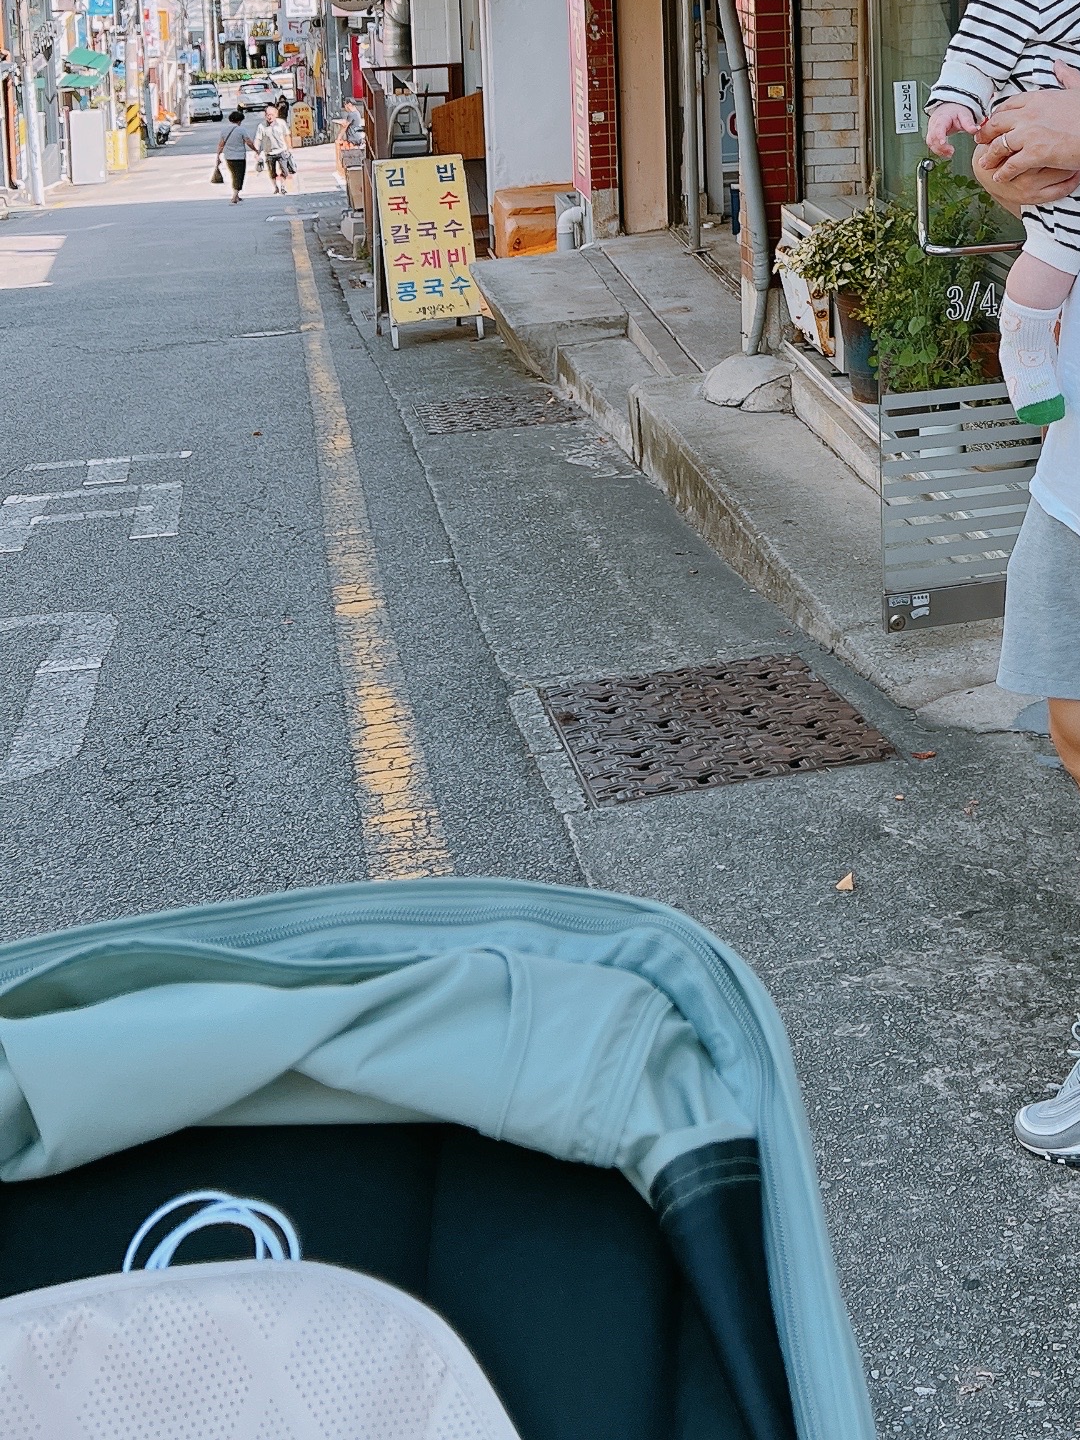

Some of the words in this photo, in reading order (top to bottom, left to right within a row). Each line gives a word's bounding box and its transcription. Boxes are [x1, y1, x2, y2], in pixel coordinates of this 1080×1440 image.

[901, 83, 912, 121] 당기시오
[391, 219, 464, 244] 칼국수
[393, 246, 468, 273] 수제비
[396, 275, 471, 302] 콩국수
